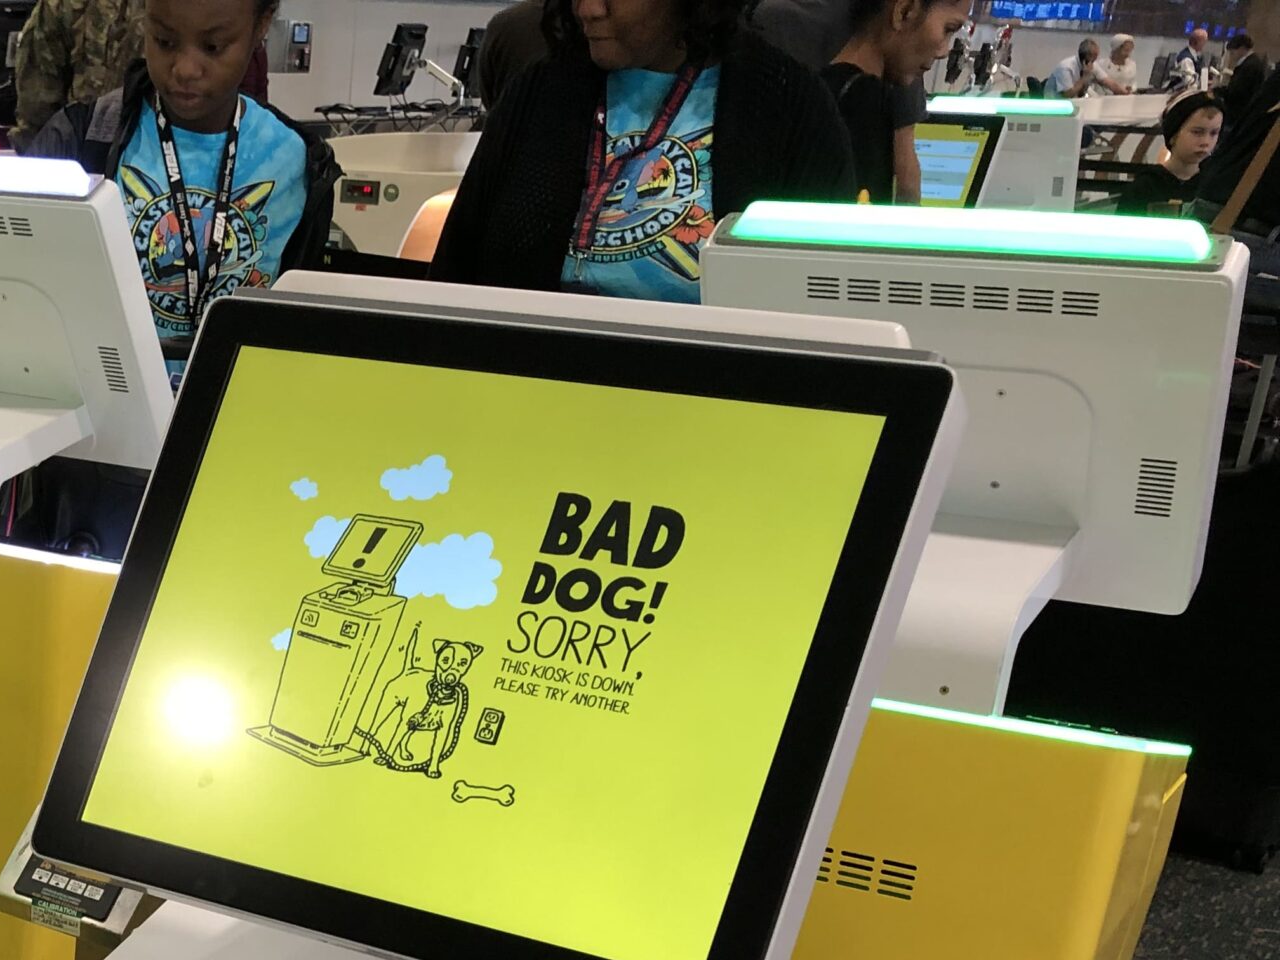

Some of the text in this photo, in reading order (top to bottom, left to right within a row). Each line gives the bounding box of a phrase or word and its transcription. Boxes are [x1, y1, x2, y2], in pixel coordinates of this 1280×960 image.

[538, 491, 686, 570] BAD
[521, 560, 669, 625] DOG!
[506, 610, 652, 681] SORRY,
[493, 676, 631, 715] PLEASE TRY ANOTHER.
[500, 657, 635, 697] THIS KIOSK IS DOWN.
[37, 900, 78, 916] CALIBRATION
